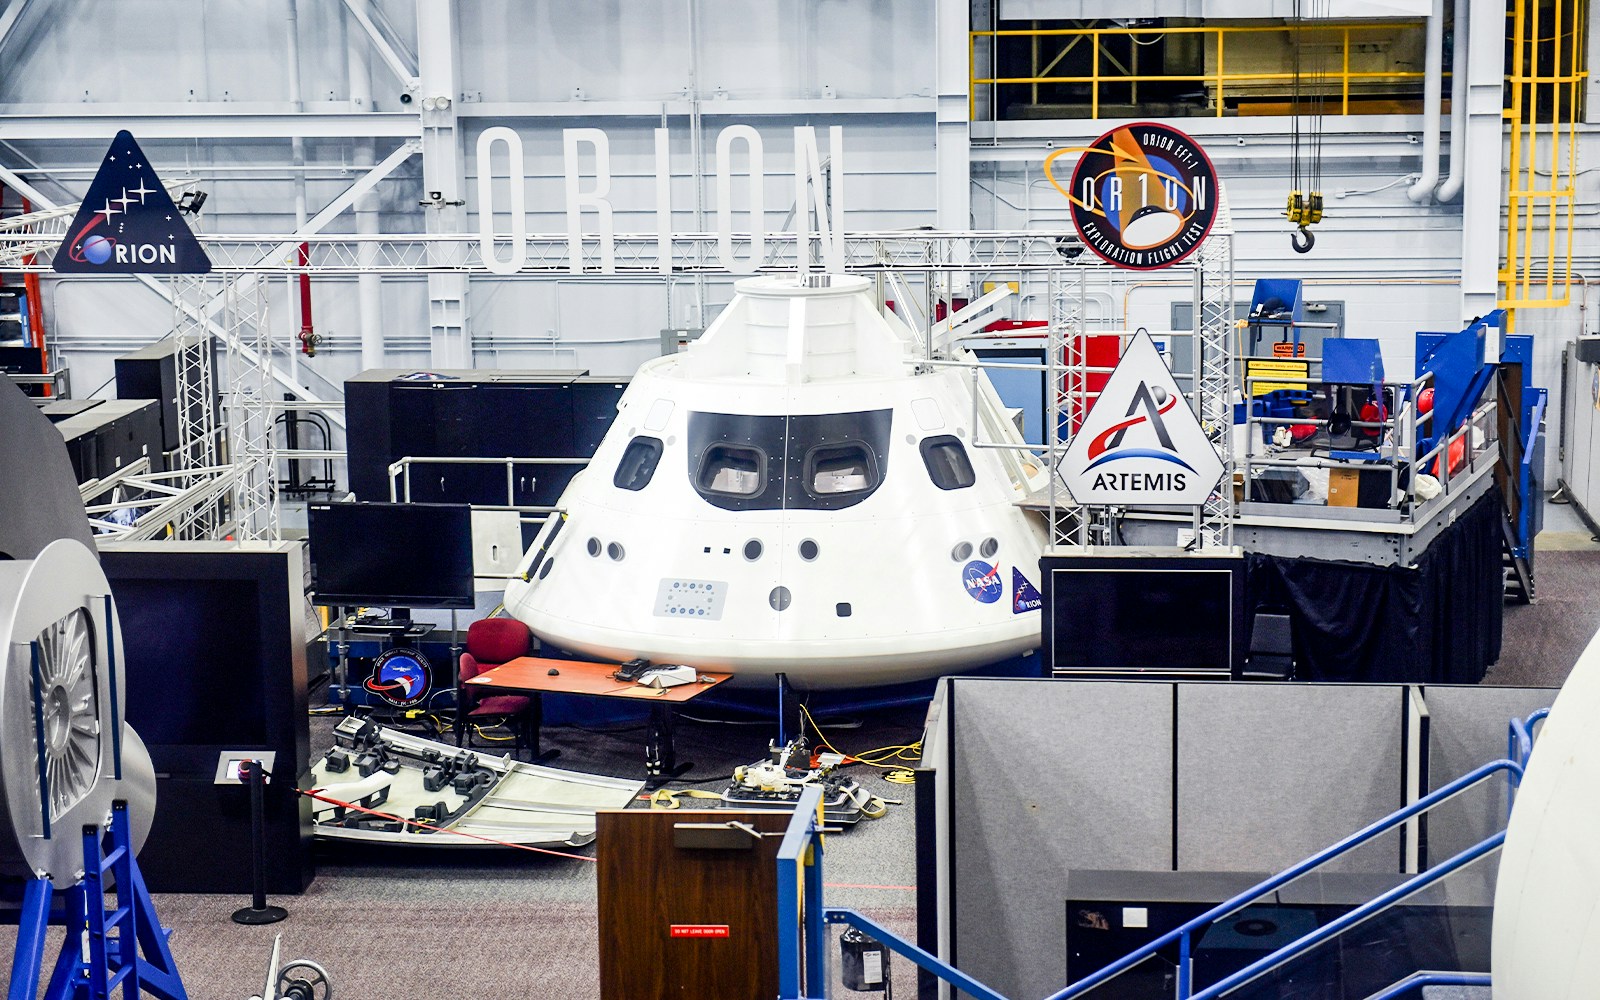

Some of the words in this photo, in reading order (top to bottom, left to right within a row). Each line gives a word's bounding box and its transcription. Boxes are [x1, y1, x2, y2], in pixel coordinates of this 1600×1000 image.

[1143, 133, 1174, 151] ORION
[1174, 144, 1198, 170] EFT-1
[476, 124, 846, 274] ORION
[1082, 222, 1143, 265] EXPLORATION
[1147, 243, 1184, 265] FLIGHT
[1181, 222, 1205, 247] TEST
[1092, 473, 1186, 491] ARTEMIS
[965, 574, 1001, 590] NASA
